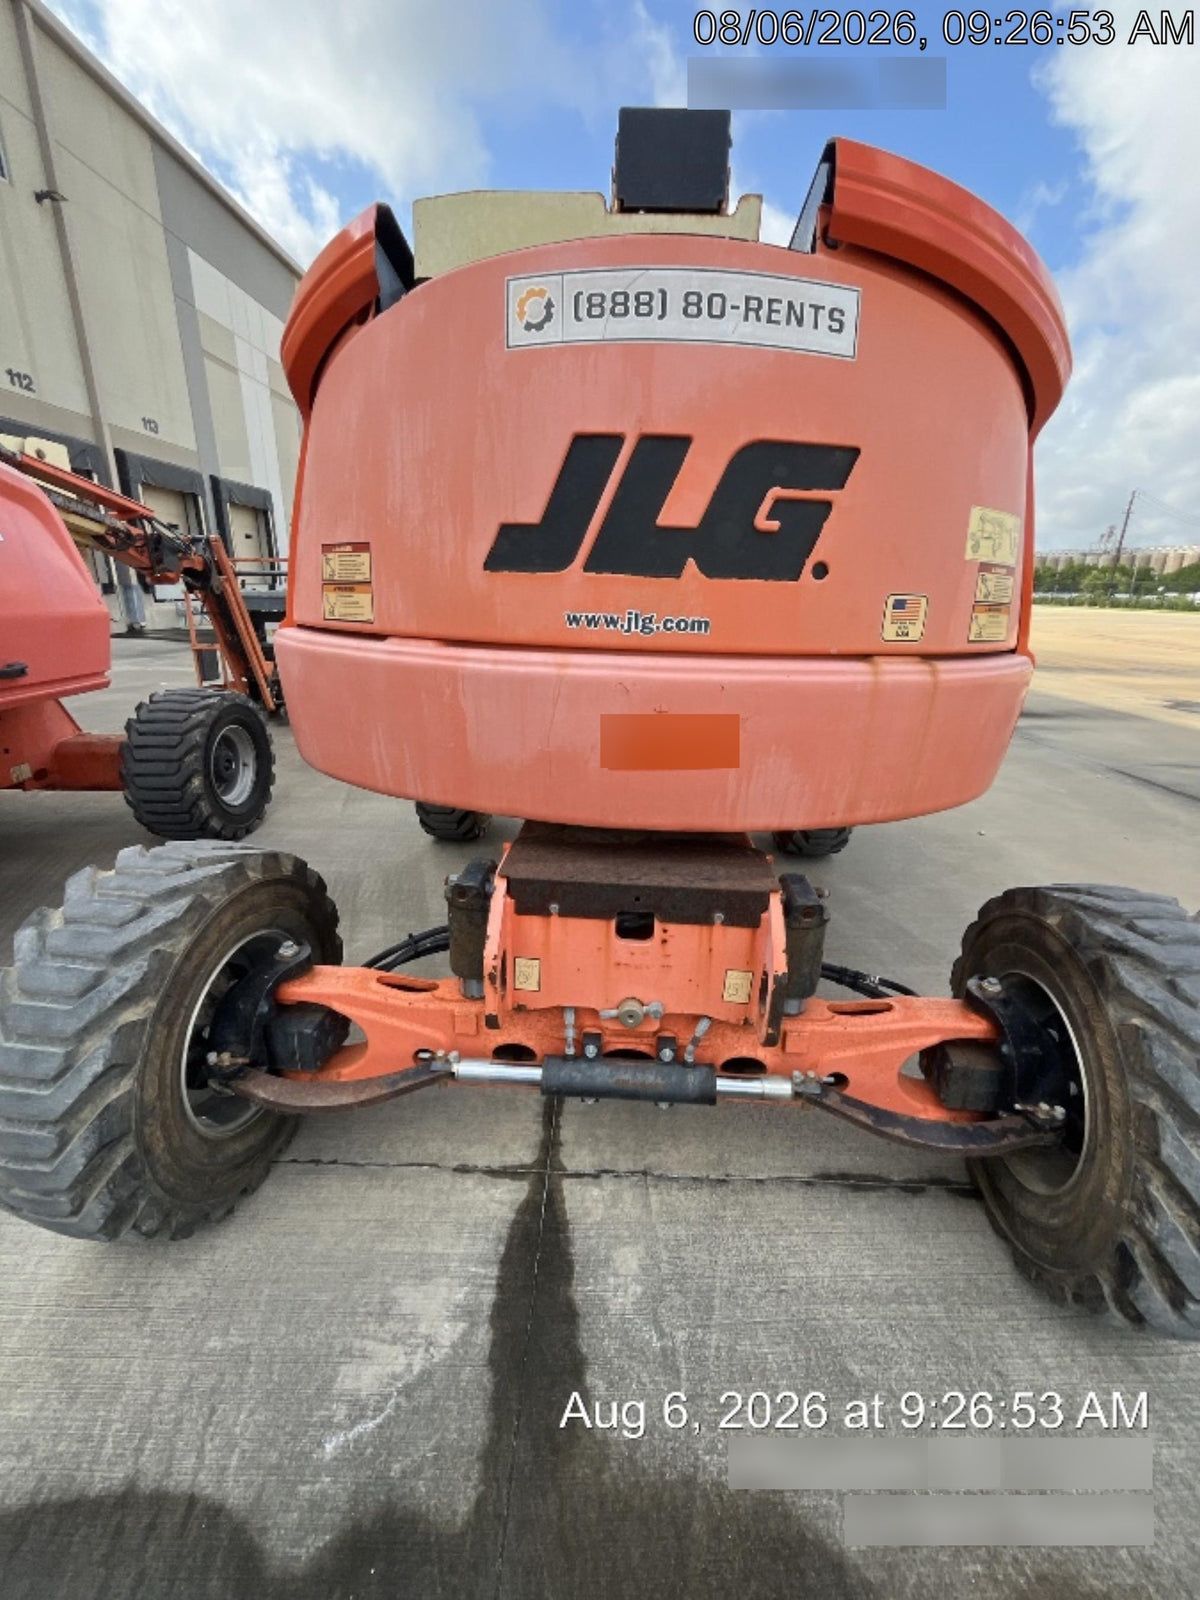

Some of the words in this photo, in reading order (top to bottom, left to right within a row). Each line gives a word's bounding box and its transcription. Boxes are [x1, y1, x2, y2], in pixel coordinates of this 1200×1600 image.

[573, 288, 668, 323] (888)
[682, 291, 846, 334] 80-RENTS
[5, 368, 36, 393] 112
[141, 417, 159, 434] 113
[565, 609, 710, 635] www.jlg.com
